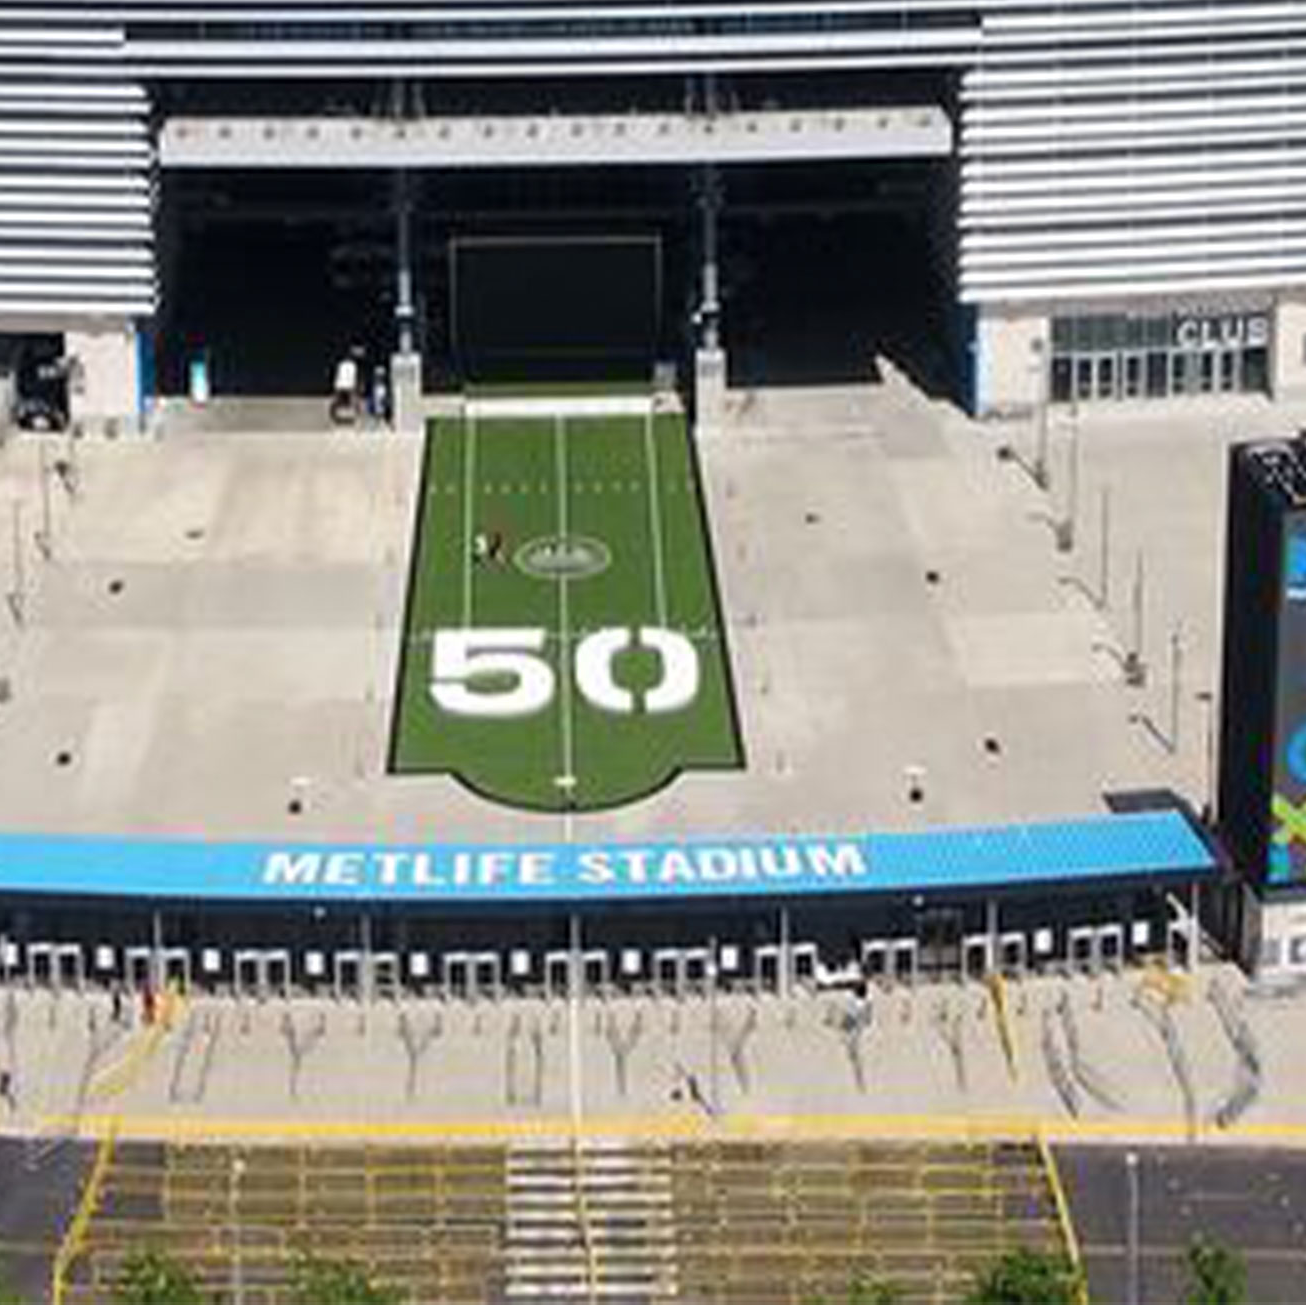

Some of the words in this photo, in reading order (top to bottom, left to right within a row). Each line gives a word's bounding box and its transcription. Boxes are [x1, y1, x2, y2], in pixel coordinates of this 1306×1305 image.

[429, 626, 700, 716] 50
[263, 851, 555, 885] METLIFE
[578, 843, 867, 884] STADIUM
